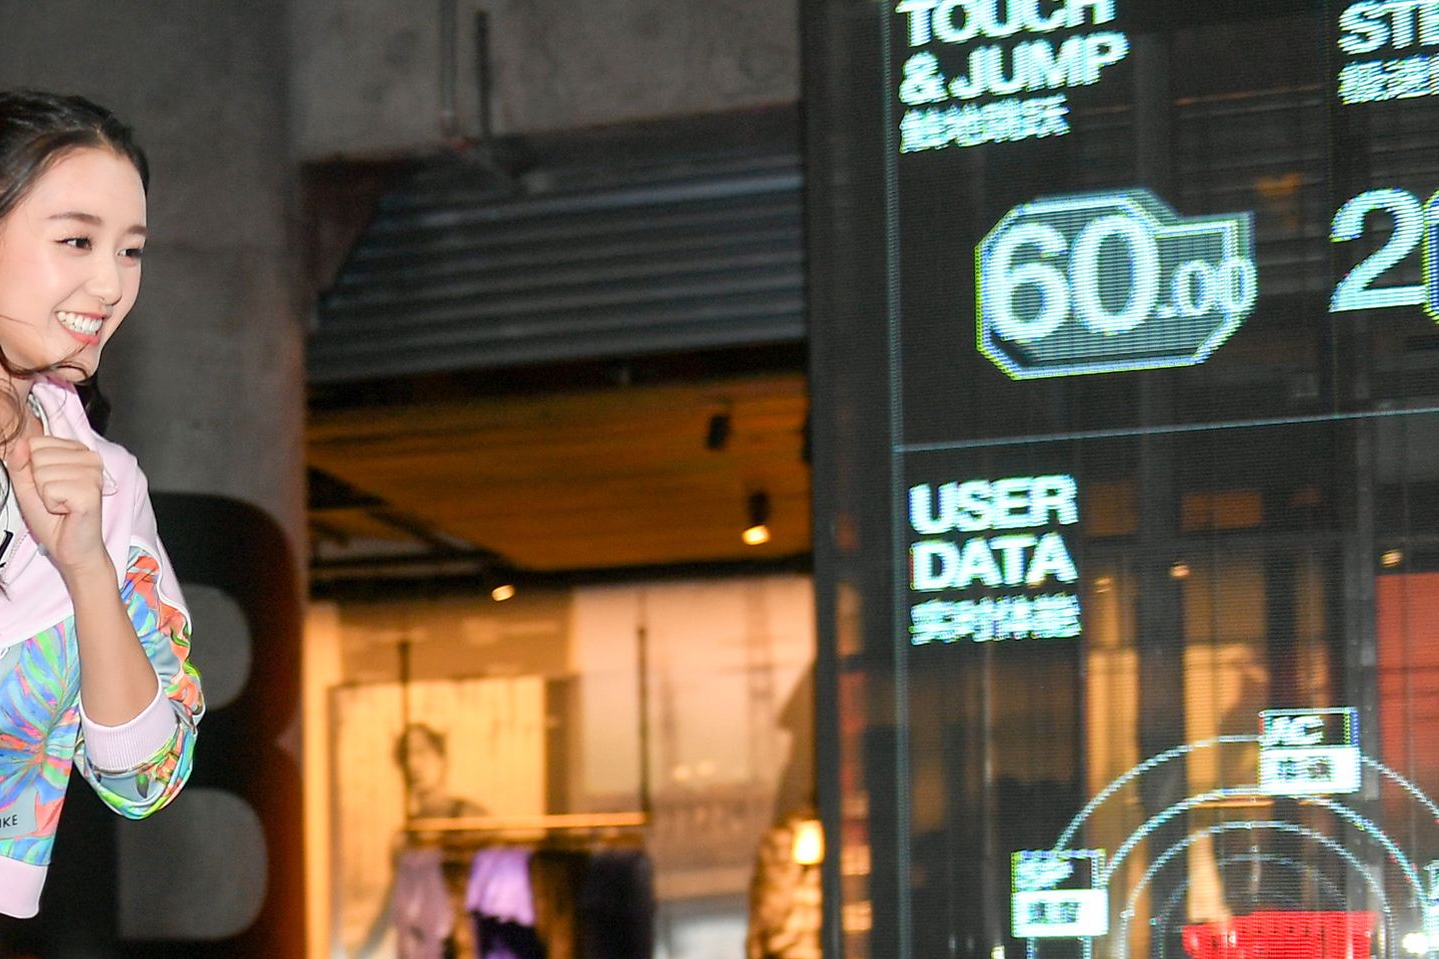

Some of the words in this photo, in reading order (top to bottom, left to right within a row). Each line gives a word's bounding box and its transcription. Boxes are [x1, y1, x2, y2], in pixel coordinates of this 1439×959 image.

[947, 31, 1131, 100] JUMP
[908, 474, 1079, 534] USER
[910, 532, 1079, 592] DATA
